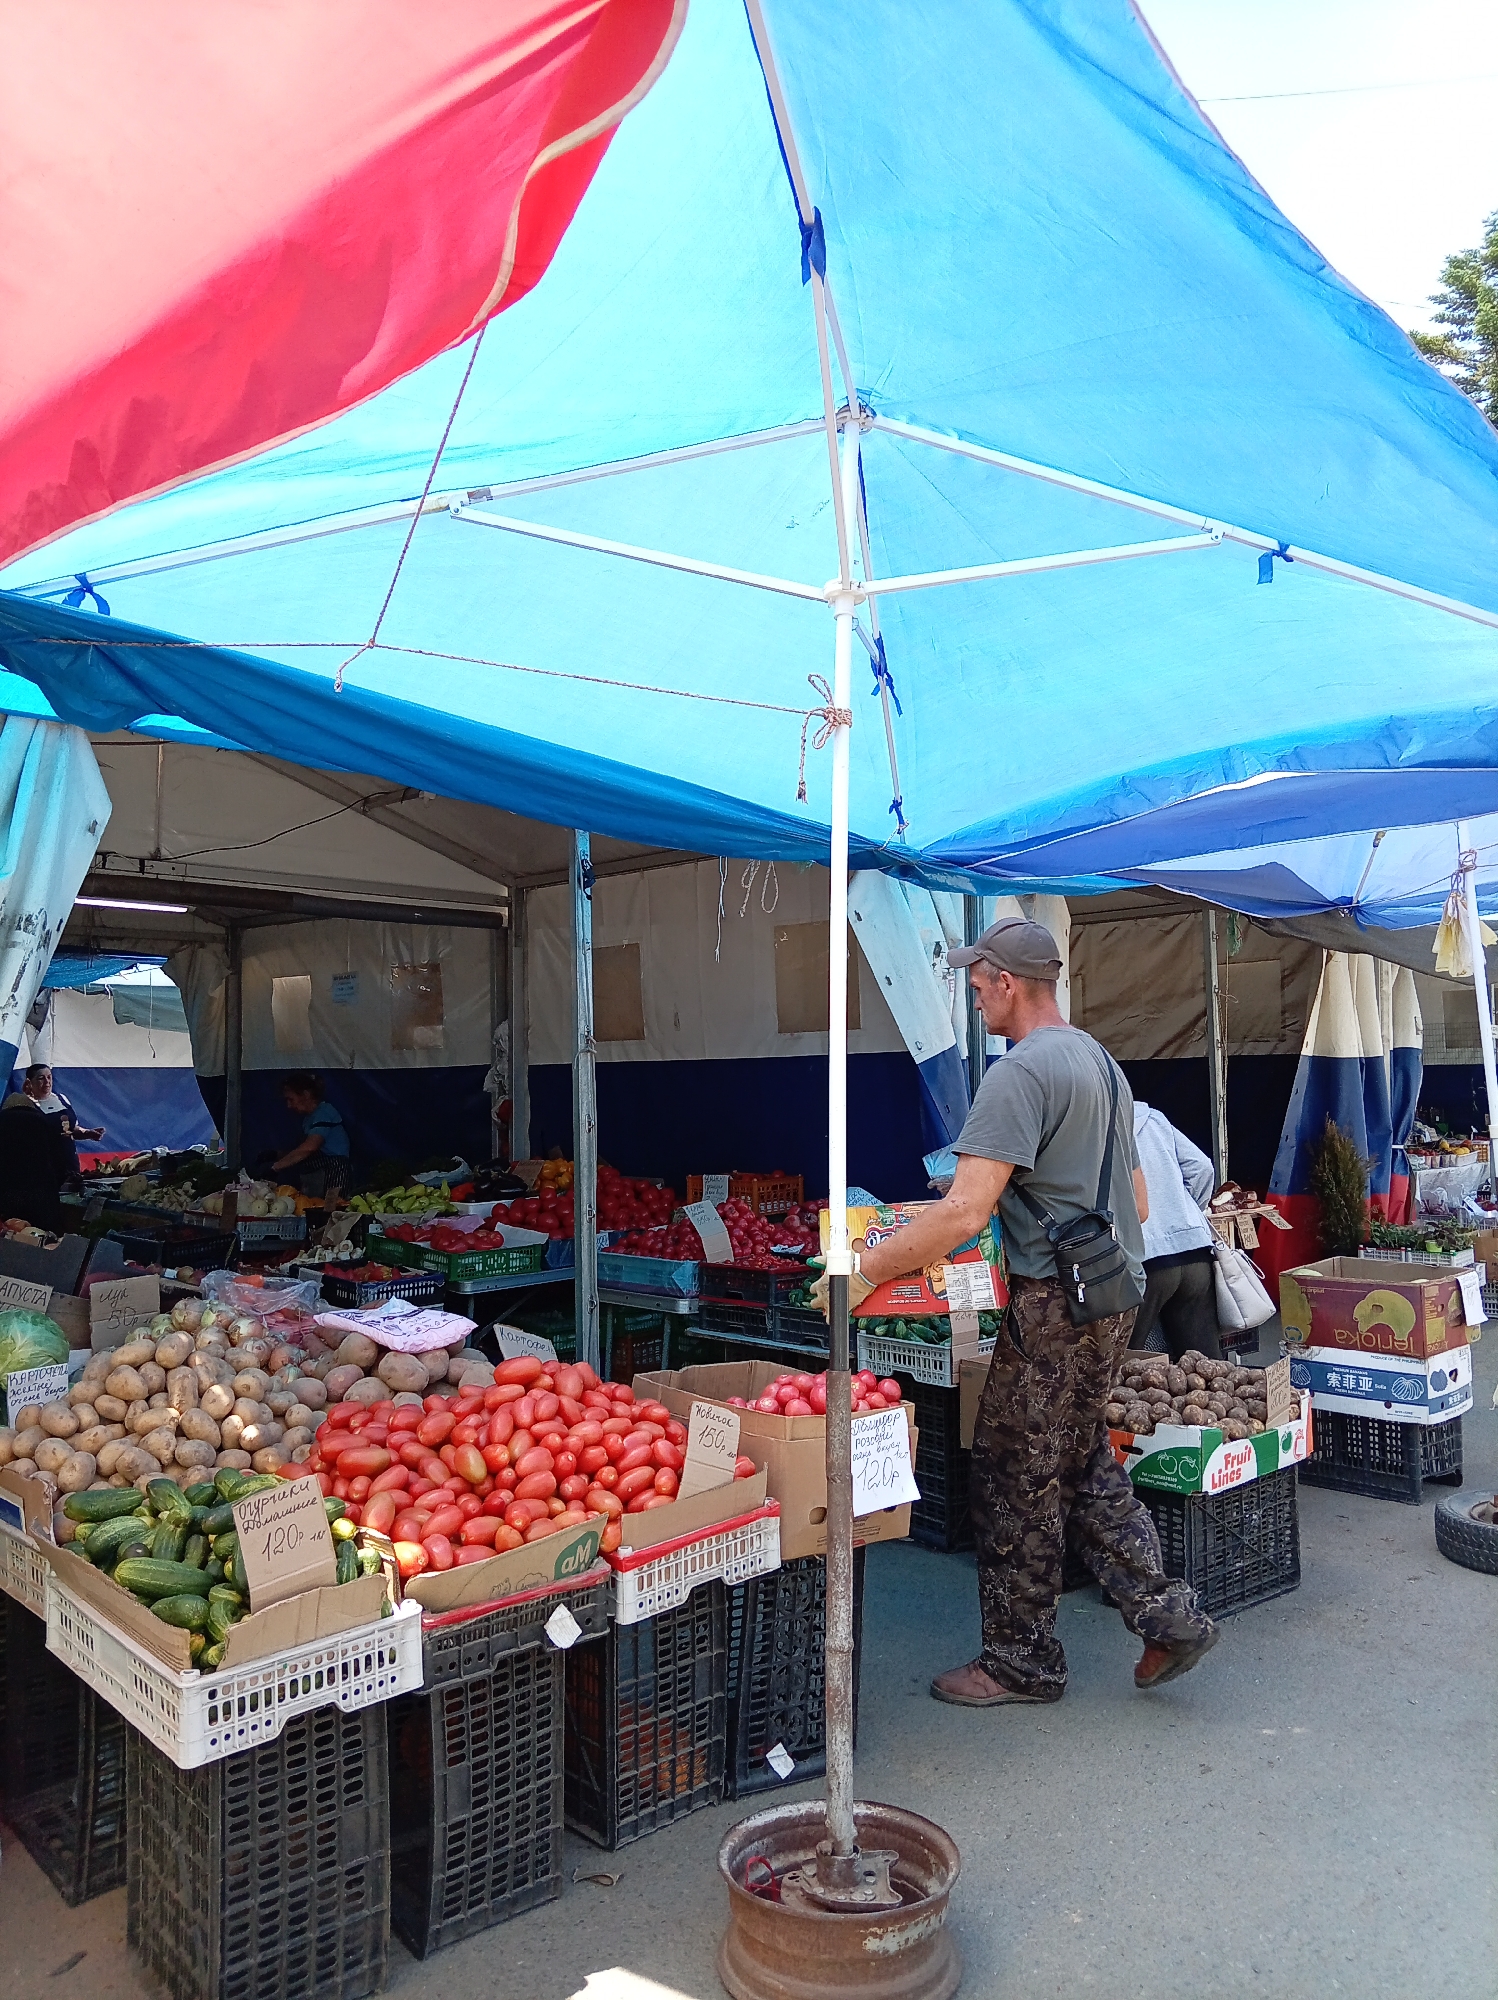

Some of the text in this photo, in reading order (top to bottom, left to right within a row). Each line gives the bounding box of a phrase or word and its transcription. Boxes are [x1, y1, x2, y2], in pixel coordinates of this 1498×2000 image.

[1333, 1328, 1421, 1356] Terioka
[1326, 1372, 1374, 1392] 索菲亚
[1224, 1444, 1253, 1471] Fruit
[1211, 1466, 1242, 1490] Lines
[238, 1481, 310, 1522] Огурчики
